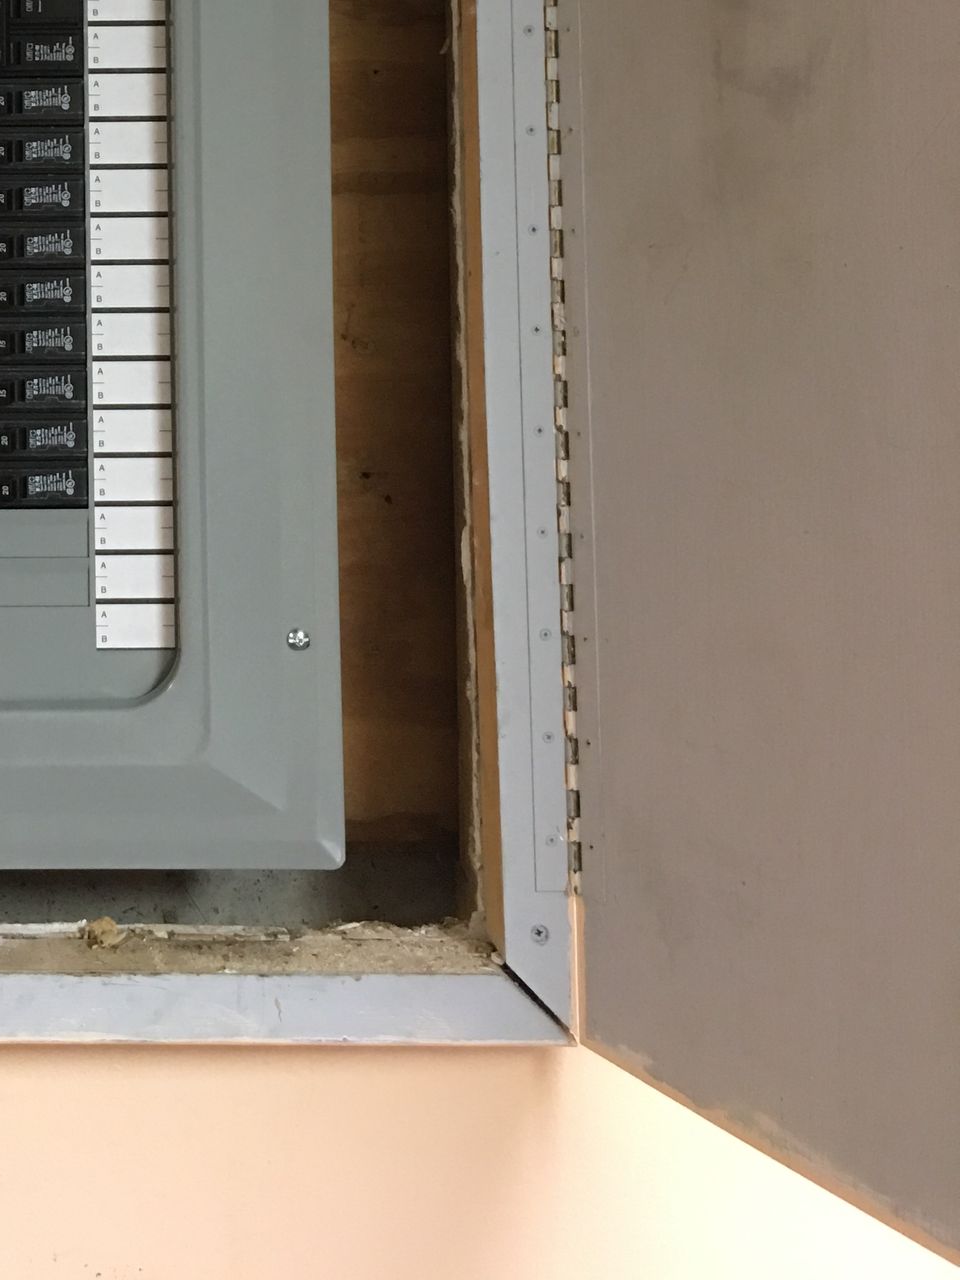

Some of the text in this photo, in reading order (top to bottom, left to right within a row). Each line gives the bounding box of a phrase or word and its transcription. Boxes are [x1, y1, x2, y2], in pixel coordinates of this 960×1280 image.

[94, 151, 101, 160] B
[0, 243, 7, 252] 20
[0, 292, 7, 301] 20
[96, 343, 103, 351] B
[0, 389, 6, 397] 15
[1, 436, 8, 445] 20
[98, 439, 105, 448] B
[2, 486, 9, 495] 20
[100, 537, 106, 545] B
[100, 586, 107, 594] B
[101, 635, 108, 643] B
